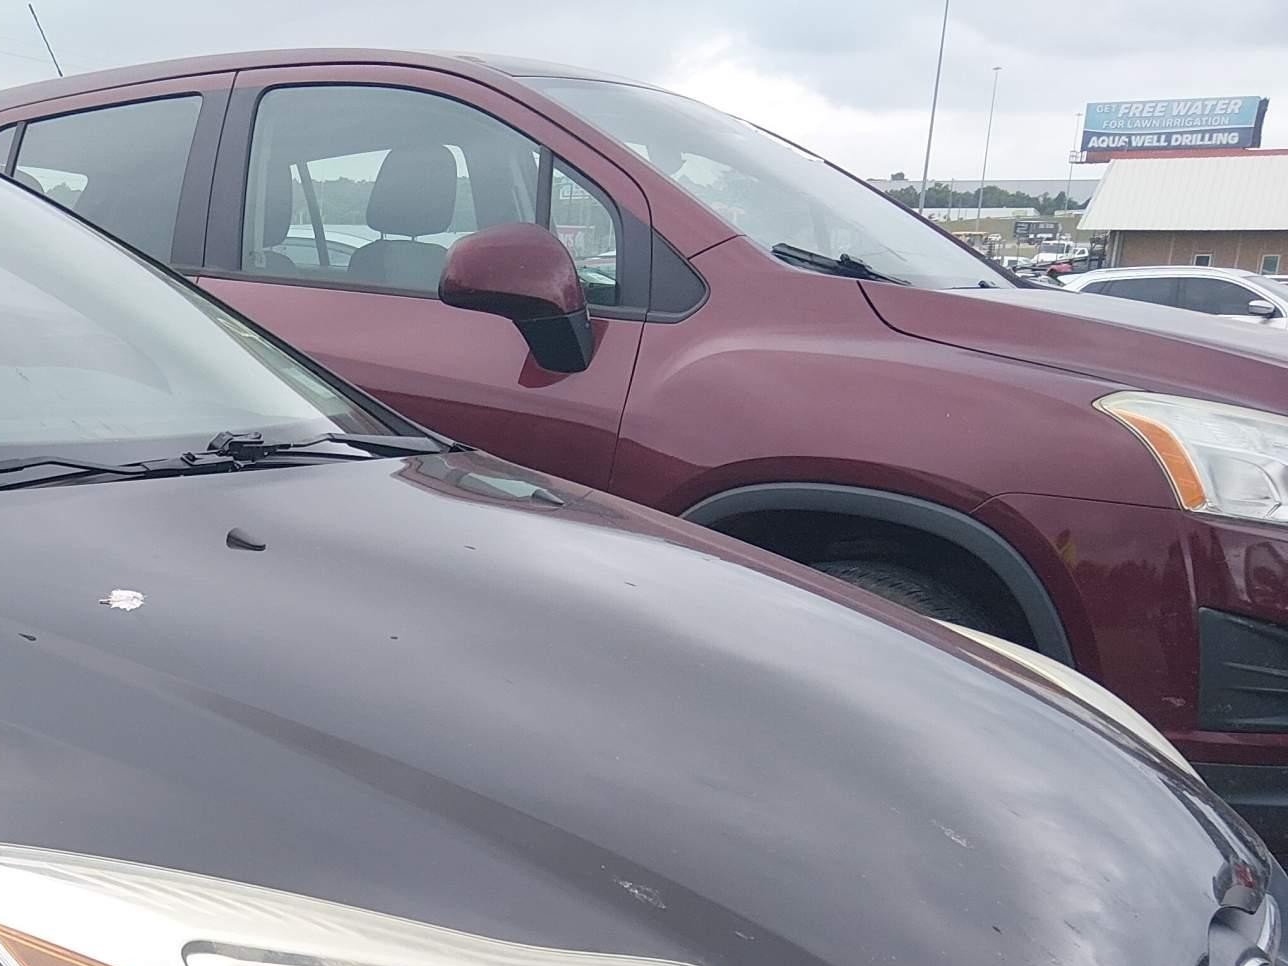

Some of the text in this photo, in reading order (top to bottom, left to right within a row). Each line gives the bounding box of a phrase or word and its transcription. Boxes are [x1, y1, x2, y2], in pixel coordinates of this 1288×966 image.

[1096, 98, 1243, 117] GET FREE WATER
[1102, 116, 1230, 129] FOR LAWN IRRIGATION
[1088, 132, 1239, 148] AQUA WELL DRILLING
